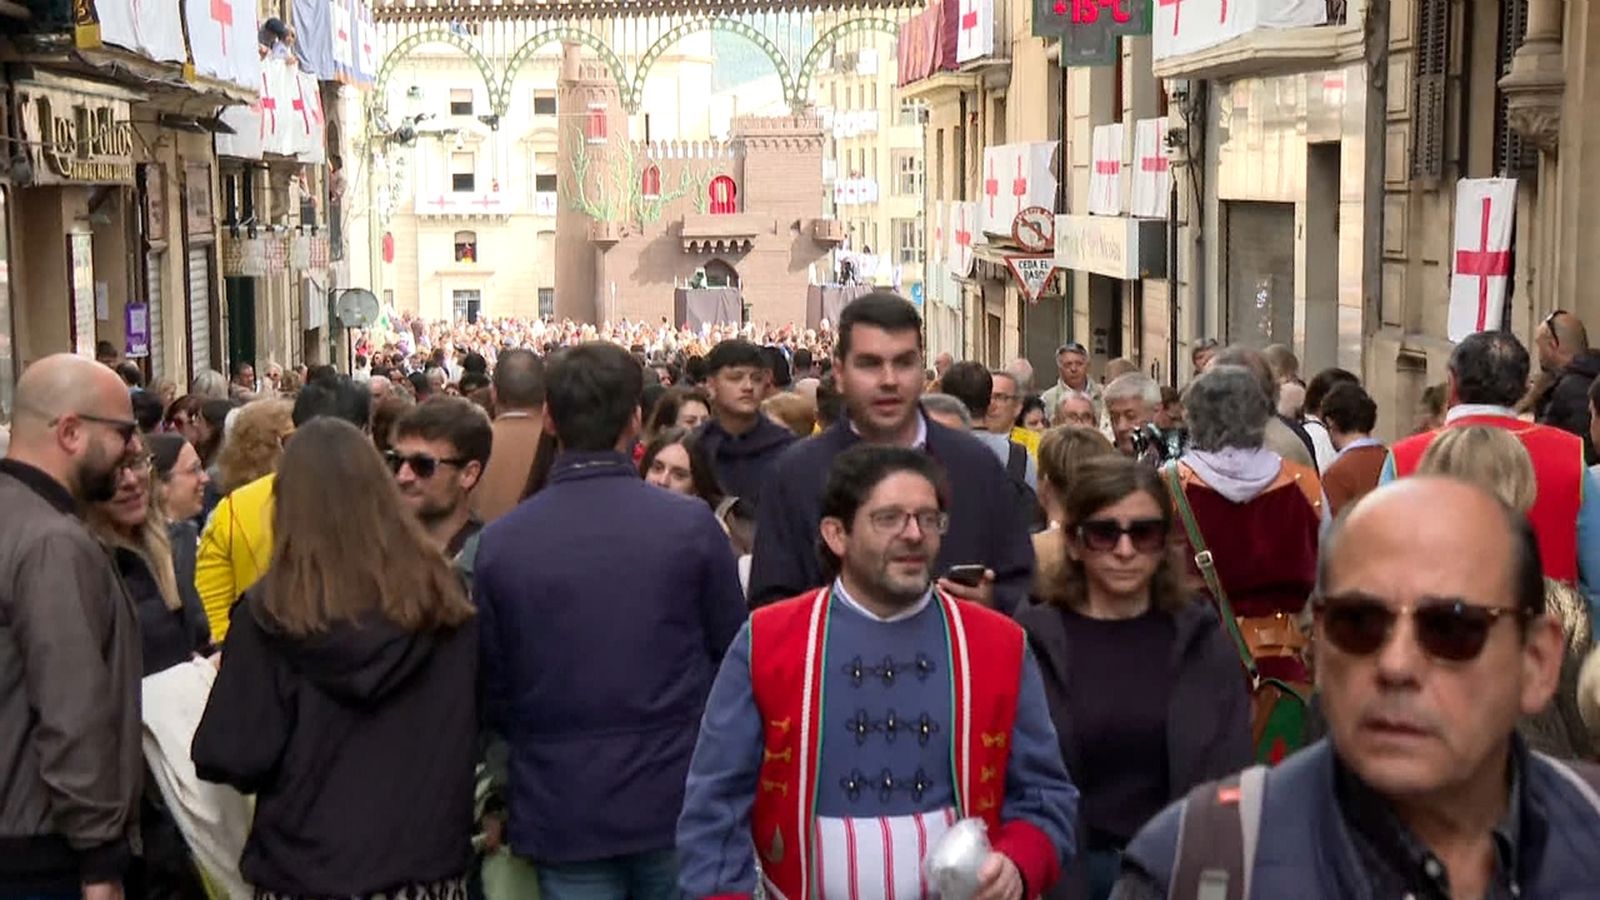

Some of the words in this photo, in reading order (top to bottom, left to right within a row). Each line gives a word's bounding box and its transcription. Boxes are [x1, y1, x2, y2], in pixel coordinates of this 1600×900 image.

[48, 95, 78, 174] Los
[1018, 260, 1038, 270] CEDA
[1040, 260, 1049, 269] EL
